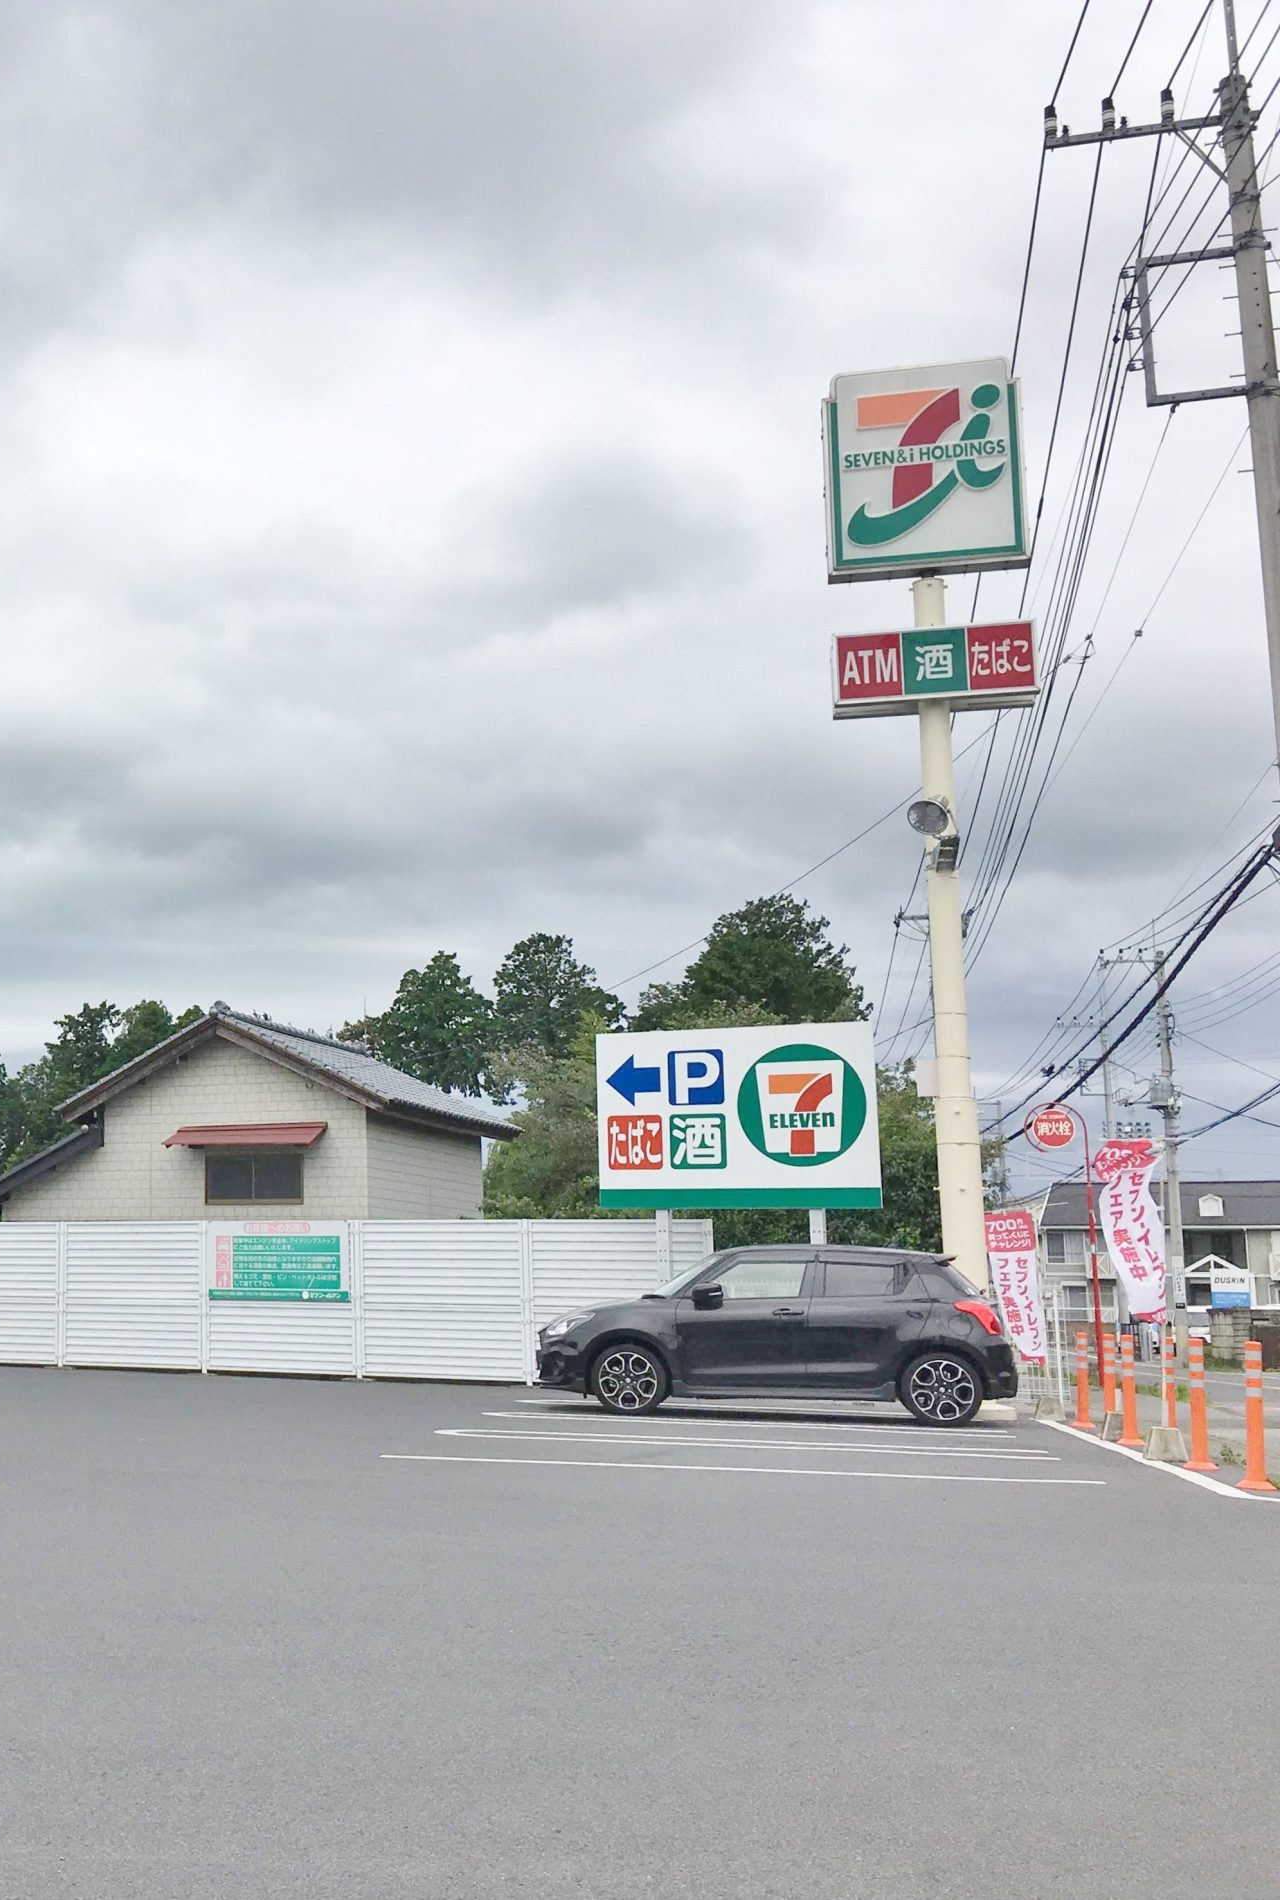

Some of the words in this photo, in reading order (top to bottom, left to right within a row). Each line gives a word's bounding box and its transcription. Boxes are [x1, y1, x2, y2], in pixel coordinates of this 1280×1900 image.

[919, 438, 1007, 462] HOLDINGS
[842, 648, 899, 686] ATM
[915, 643, 954, 681] 酒
[970, 637, 1032, 677] たばこ
[674, 1052, 721, 1104] P
[609, 1119, 662, 1166] たばこ
[672, 1117, 722, 1166] 酒
[1036, 1120, 1072, 1137] 消火栓
[996, 1257, 1026, 1337] フェア実施中
[1213, 1276, 1246, 1285] DUSKIN
